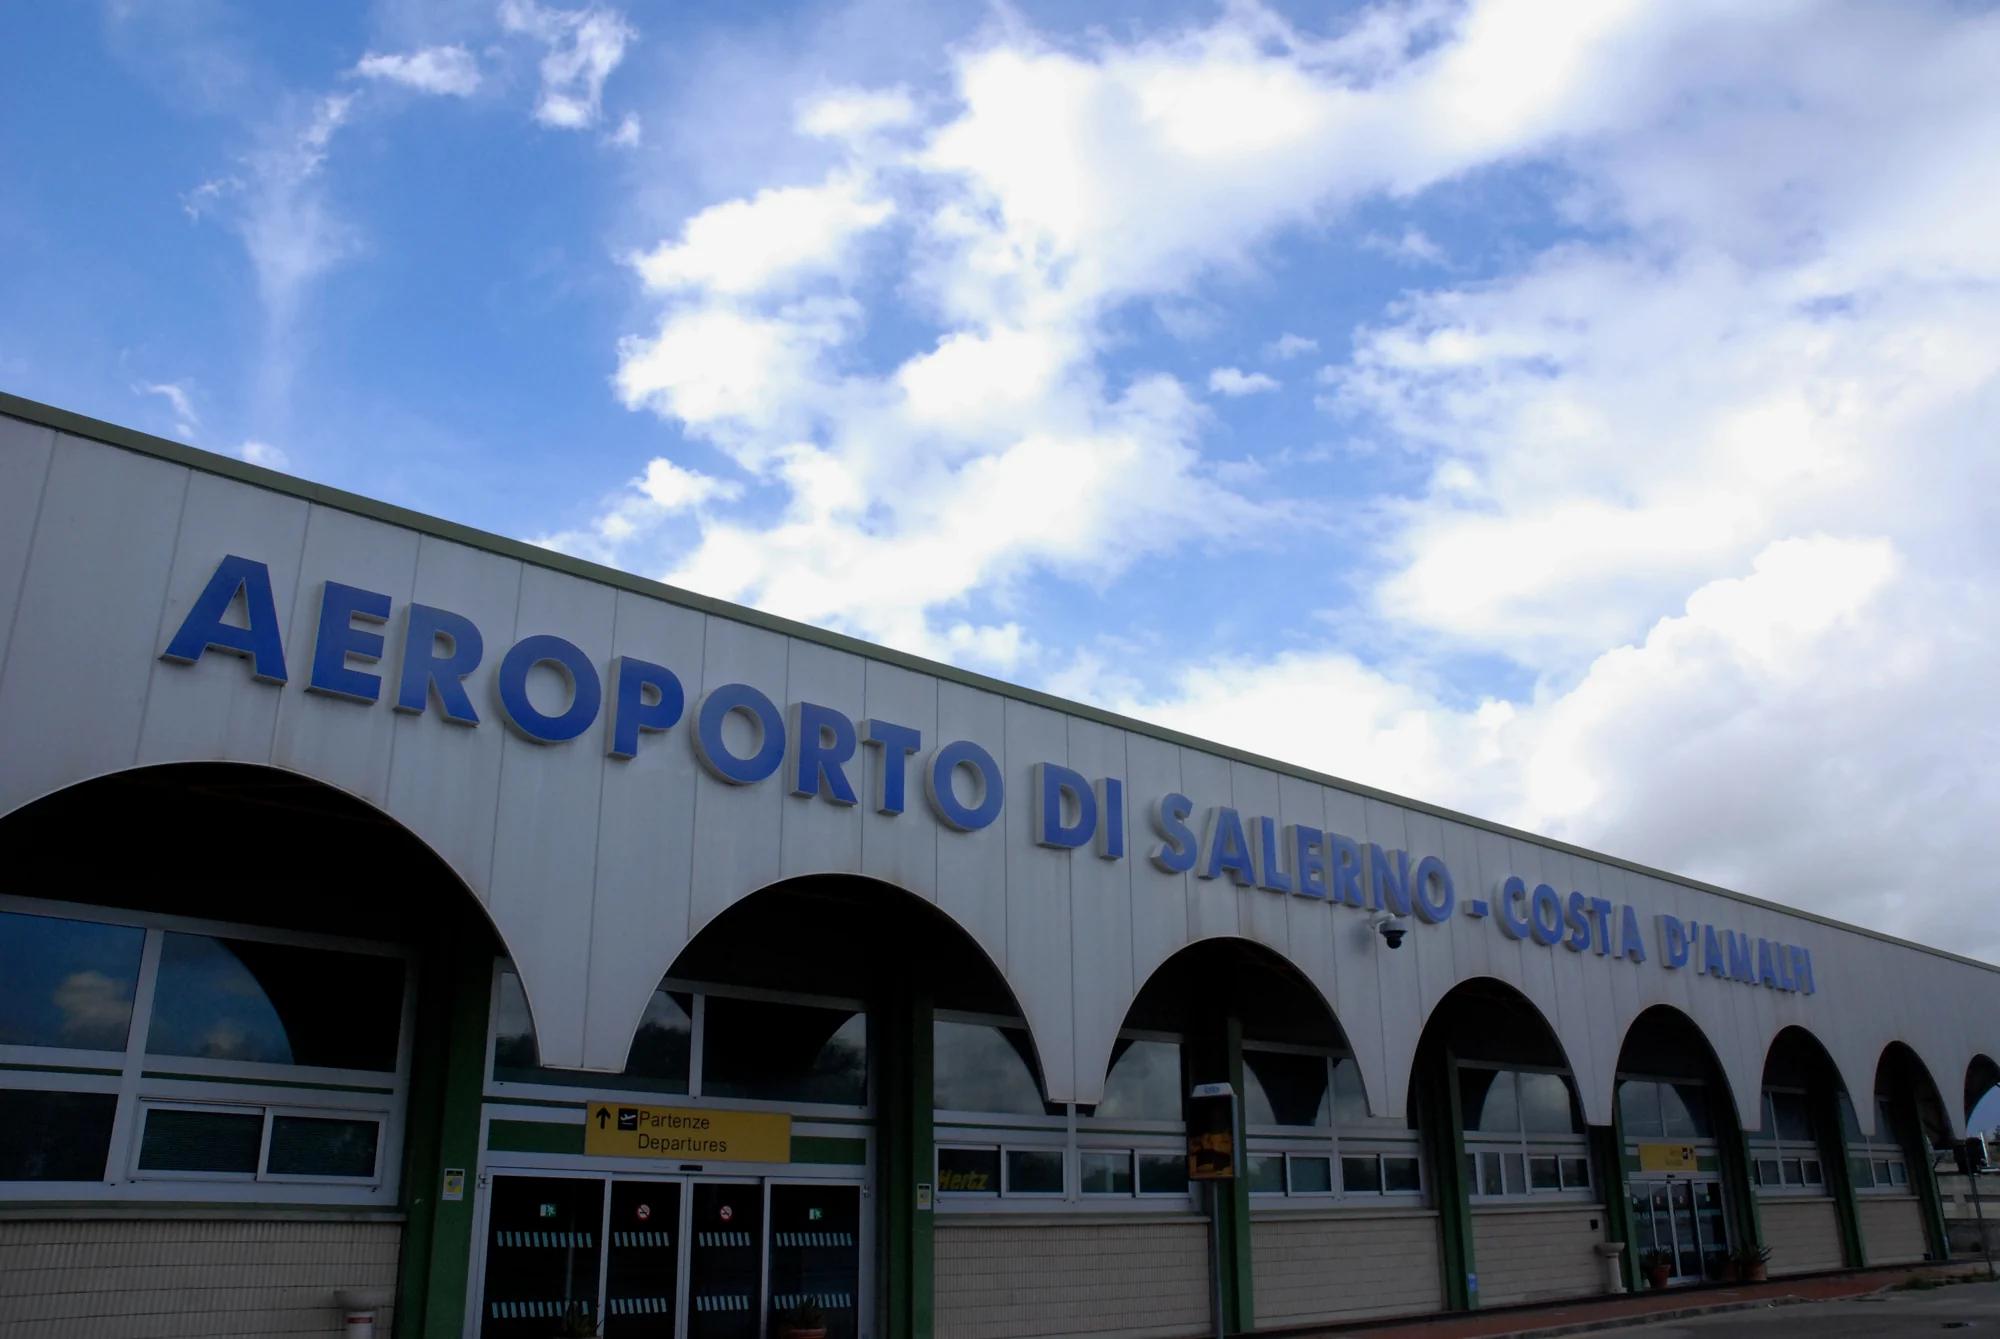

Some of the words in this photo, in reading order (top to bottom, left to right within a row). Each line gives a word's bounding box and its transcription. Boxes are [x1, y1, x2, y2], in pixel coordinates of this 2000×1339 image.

[160, 554, 1004, 832] AEROPORTO
[1036, 762, 1124, 860] DI
[1151, 793, 1455, 924] SALERNO
[1496, 876, 1646, 964] COSTA
[1656, 914, 1815, 996] D'AMALFI
[639, 1110, 710, 1130] Partenze
[638, 1133, 728, 1153] Departures
[938, 1169, 989, 1190] Hertz
